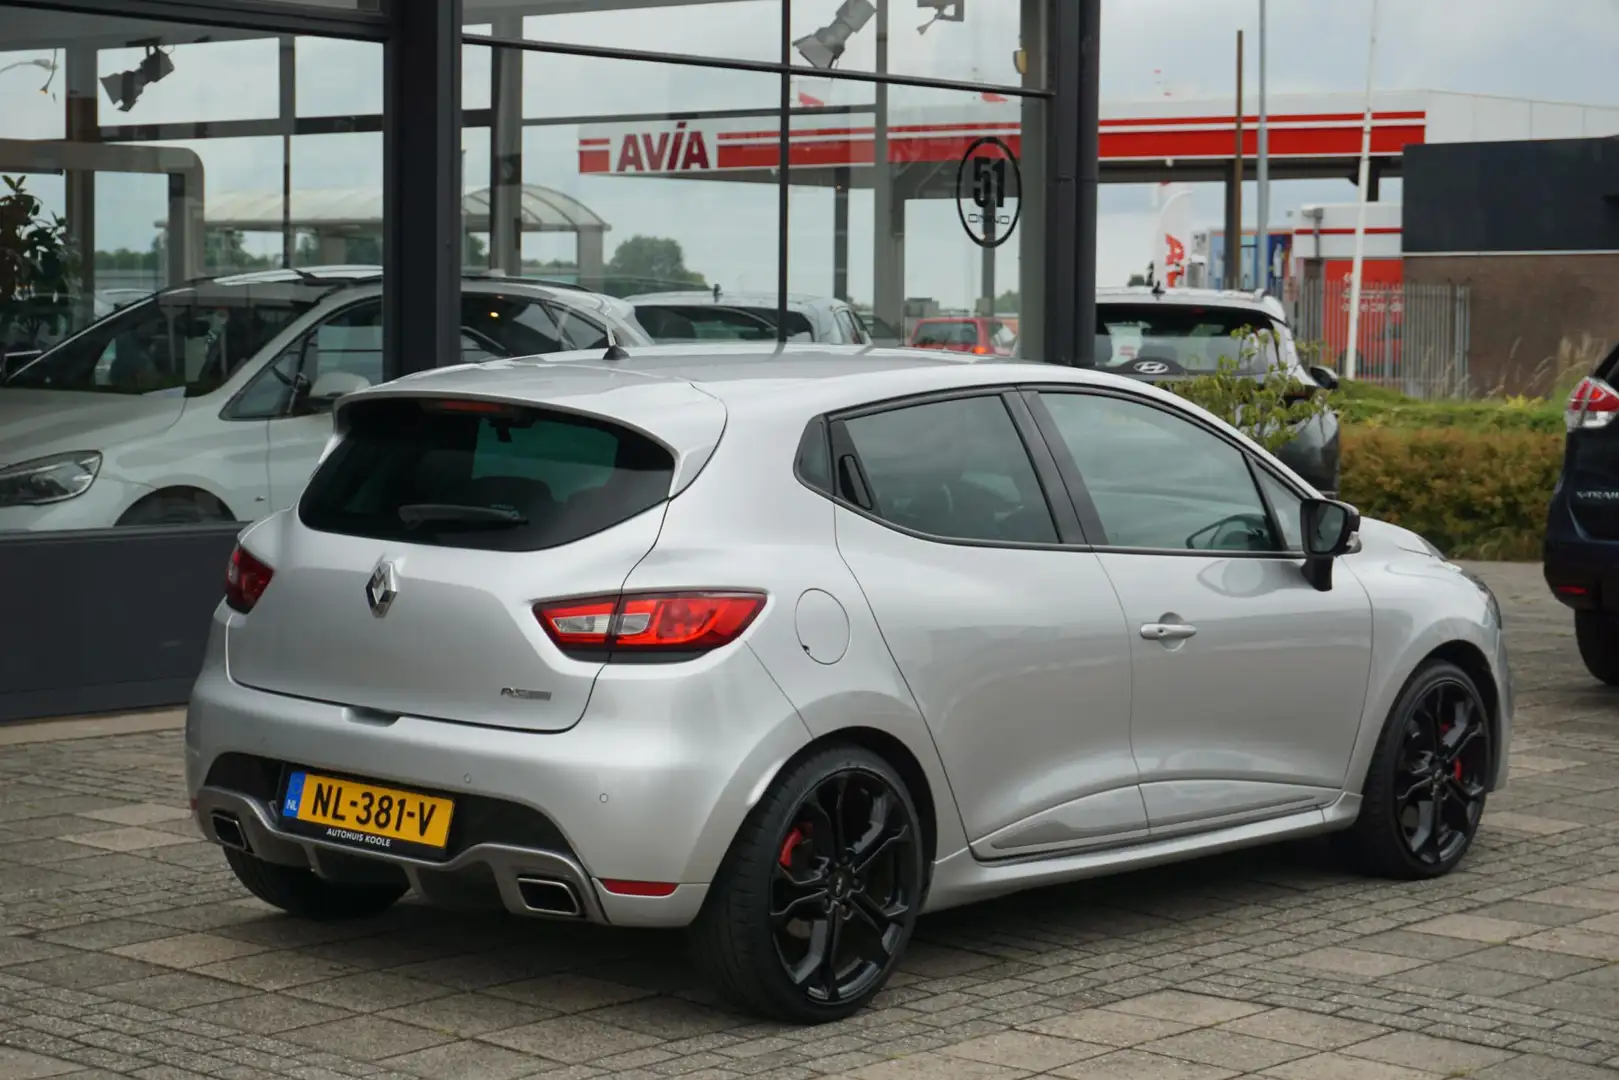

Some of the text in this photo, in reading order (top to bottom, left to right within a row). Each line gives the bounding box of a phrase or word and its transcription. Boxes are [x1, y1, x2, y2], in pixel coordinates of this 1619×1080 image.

[973, 155, 1005, 208] 51
[286, 799, 298, 811] NL
[311, 782, 437, 837] NL-381-V
[326, 828, 392, 847] AUTOHUIS KOOLE
